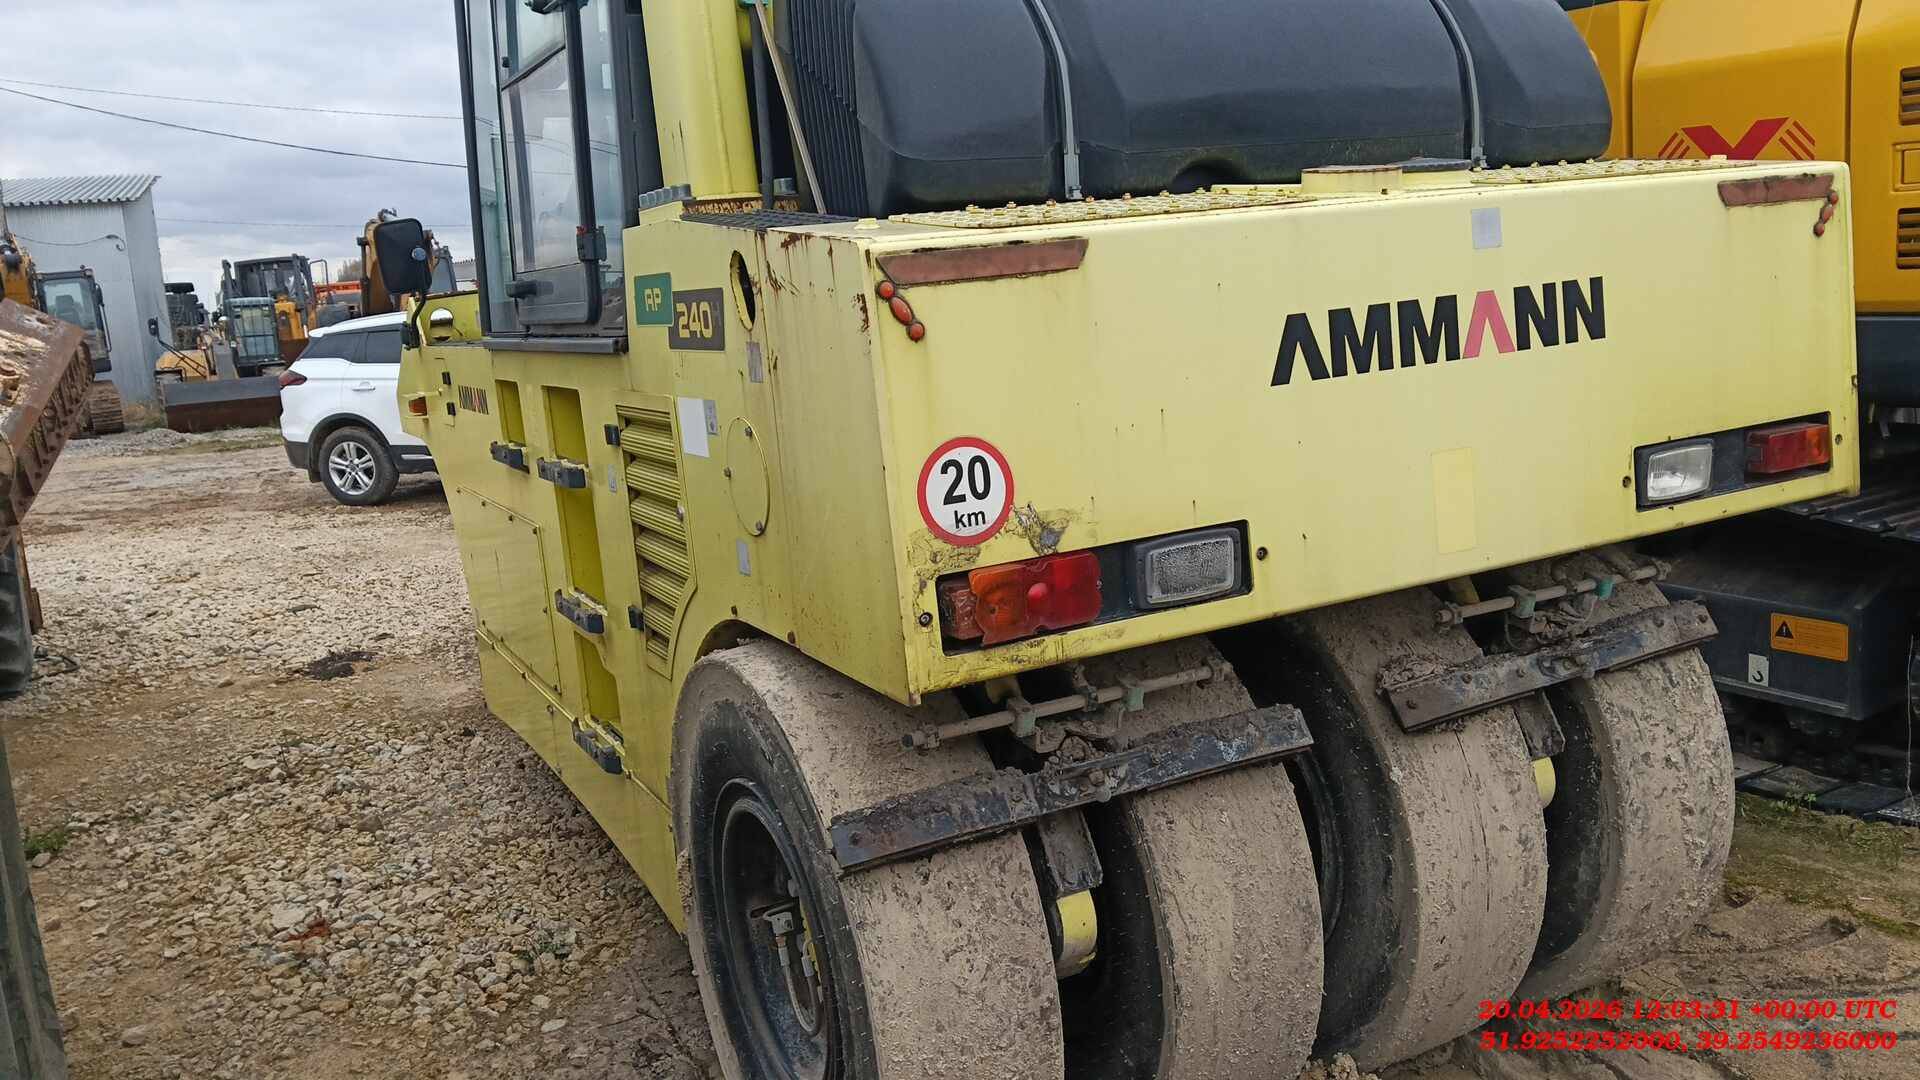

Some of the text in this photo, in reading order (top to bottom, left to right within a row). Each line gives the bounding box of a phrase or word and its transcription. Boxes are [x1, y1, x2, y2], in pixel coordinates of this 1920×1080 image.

[1270, 276, 1606, 387] AMMANN
[940, 455, 991, 505] 20
[954, 510, 986, 529] km
